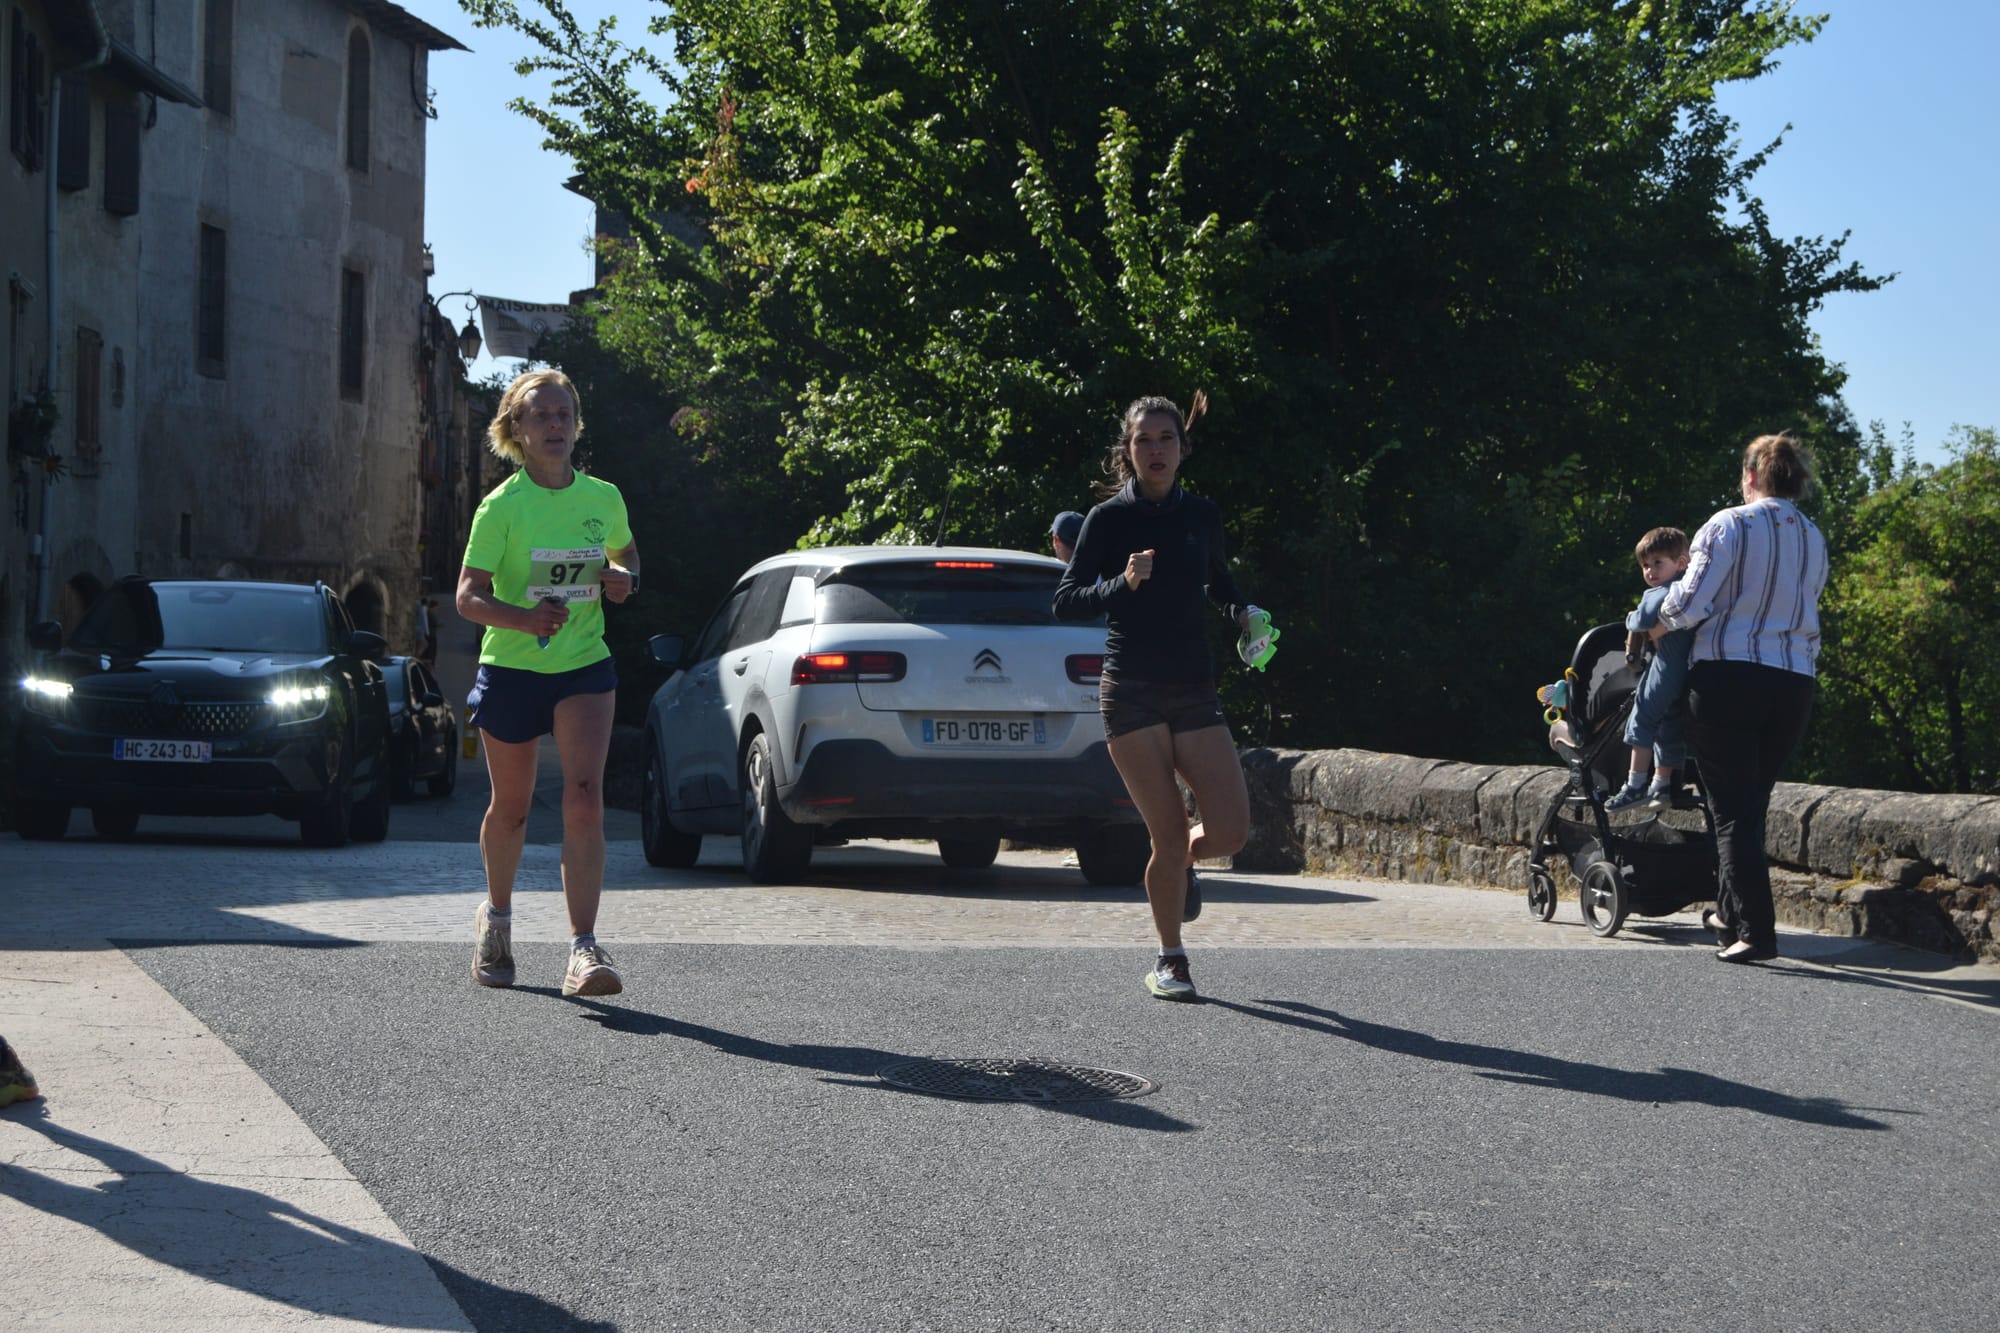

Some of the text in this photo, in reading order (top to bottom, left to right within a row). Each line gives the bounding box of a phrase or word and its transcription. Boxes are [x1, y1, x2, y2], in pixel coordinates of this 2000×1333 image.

[483, 299, 548, 313] MAISON
[550, 563, 586, 585] 97
[935, 721, 1031, 742] FD-078-GF
